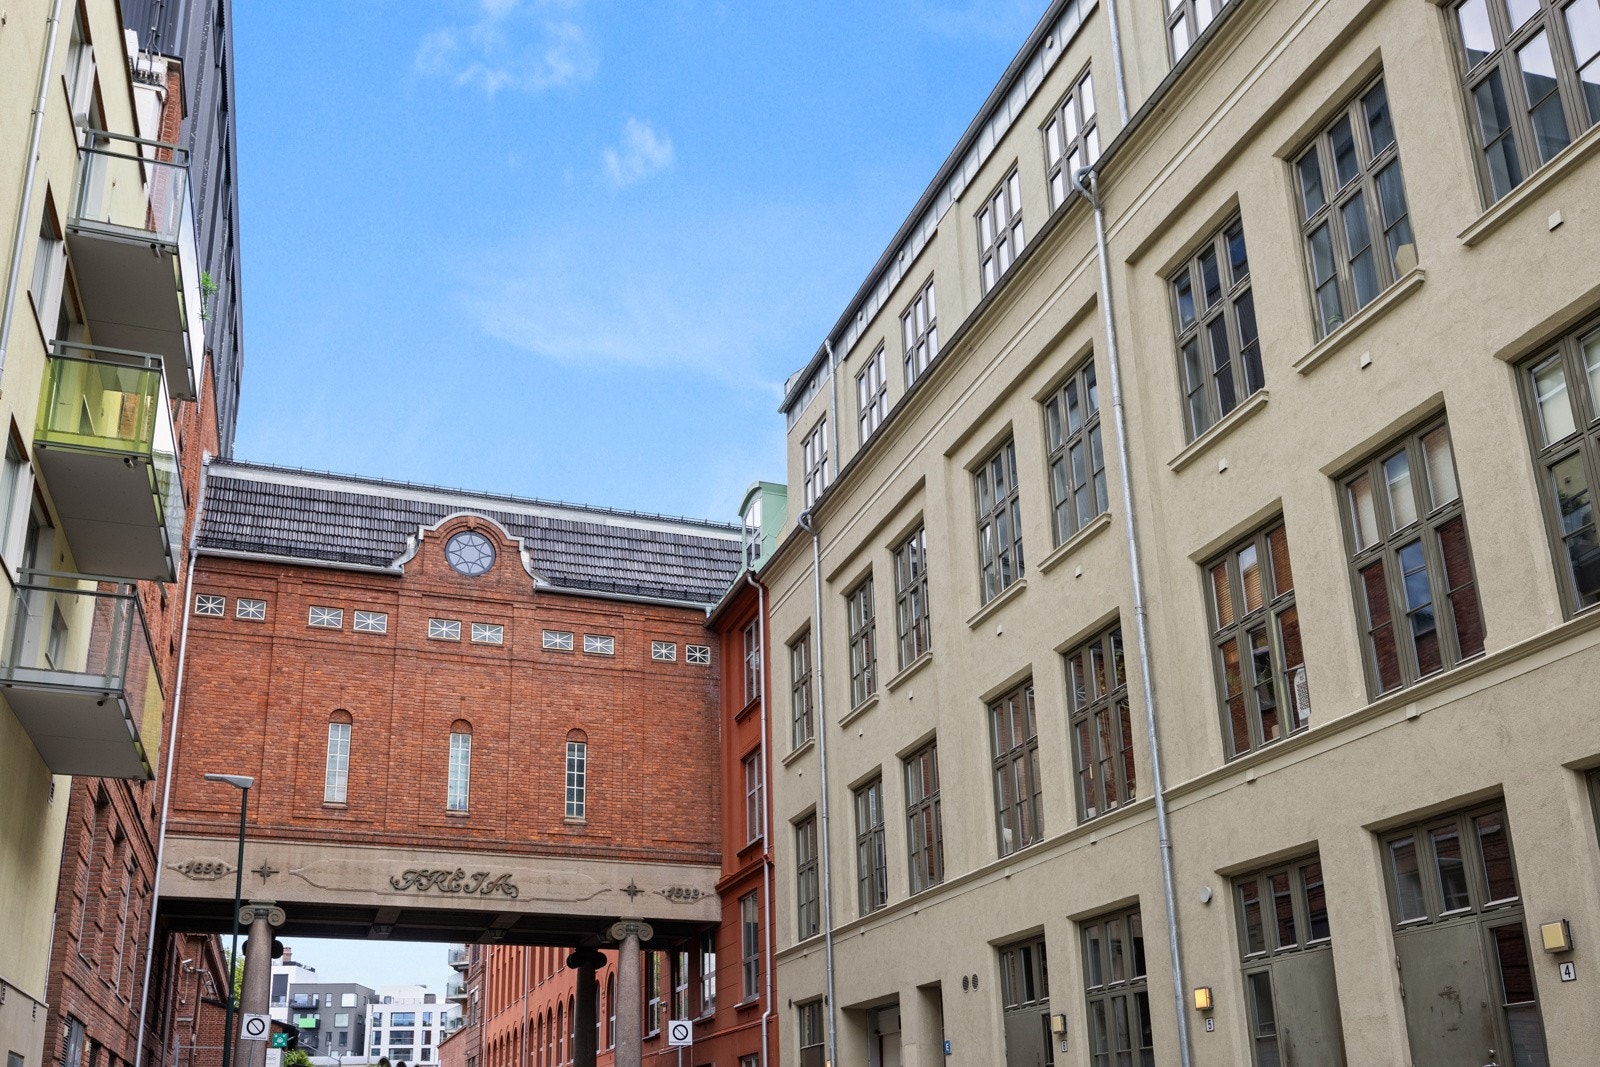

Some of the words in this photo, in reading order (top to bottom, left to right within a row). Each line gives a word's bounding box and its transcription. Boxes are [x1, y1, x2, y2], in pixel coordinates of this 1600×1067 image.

[390, 868, 519, 898] FREIA
[668, 887, 699, 899] 1922
[1564, 965, 1571, 978] 4
[1207, 1019, 1212, 1030] 5
